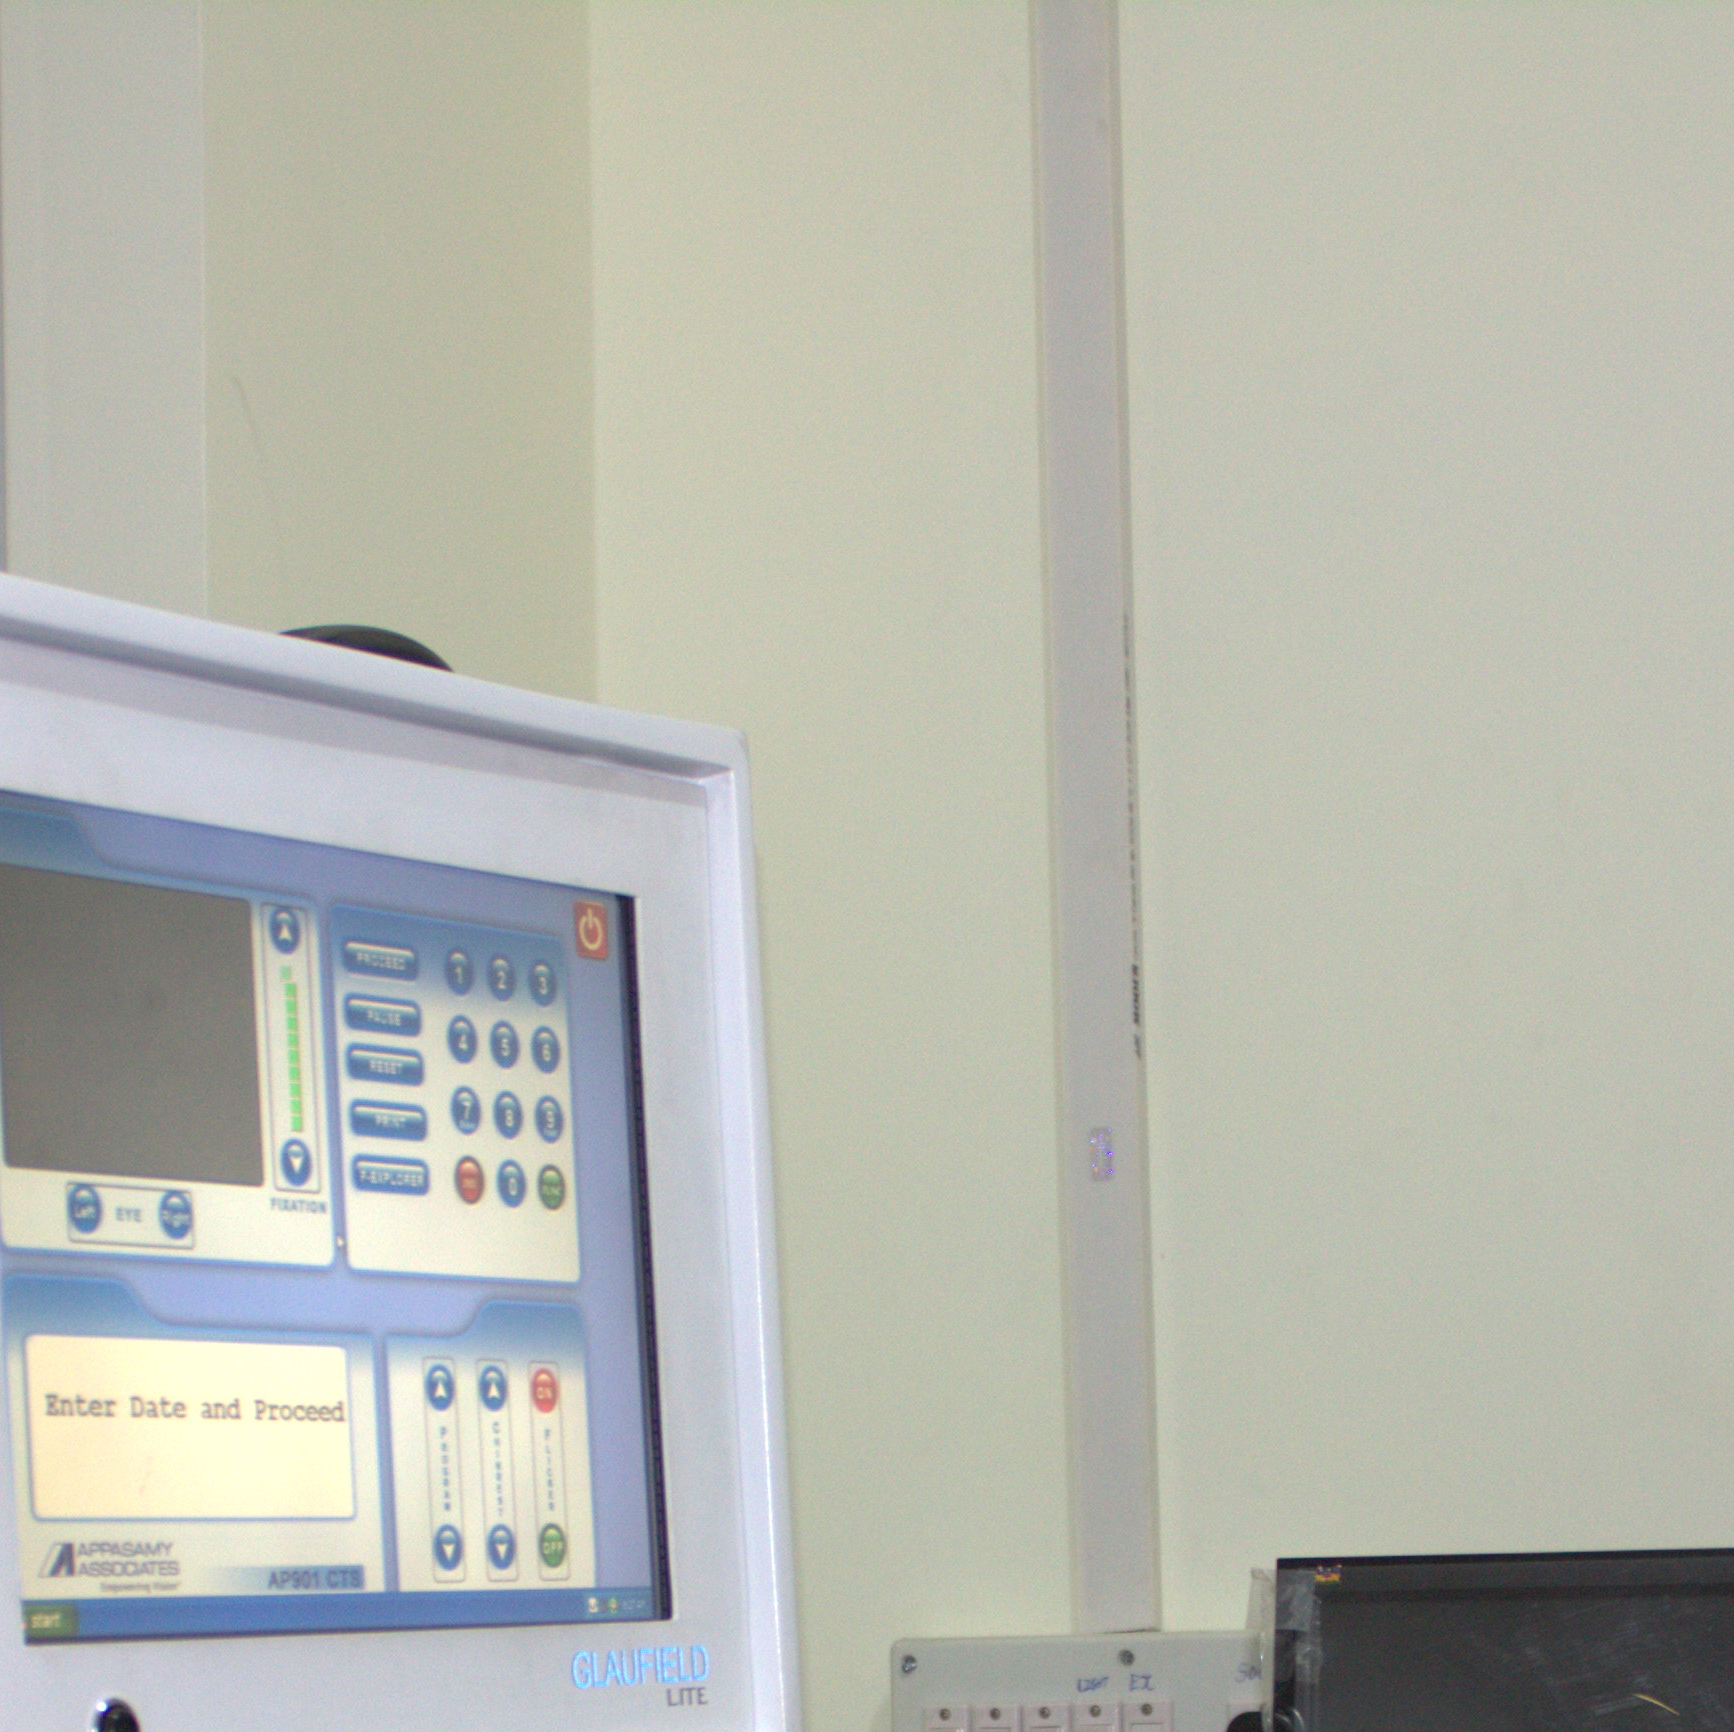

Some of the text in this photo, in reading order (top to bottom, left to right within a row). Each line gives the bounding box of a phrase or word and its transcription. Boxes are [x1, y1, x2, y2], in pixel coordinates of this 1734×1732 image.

[356, 951, 406, 971] PROCEED
[454, 965, 548, 995] 1 2 3
[458, 1033, 551, 1062] 4 5 6
[369, 1060, 403, 1075] RESET
[375, 1114, 406, 1129] PRINT
[461, 1100, 555, 1129] 7 8 9
[507, 1177, 517, 1196] 0
[270, 1197, 328, 1214] FIXATION
[73, 1203, 190, 1228] Left EYE Right
[536, 1385, 553, 1399] ON
[44, 1394, 346, 1423] Enter Date and Proceed
[77, 1542, 175, 1558] APPASAMY
[542, 1541, 564, 1554] OFF
[78, 1560, 181, 1578] ASSOCIATES
[267, 1569, 362, 1590] AP901 CTS
[30, 1612, 62, 1629] start
[571, 1644, 710, 1690] GLAUFIELD
[667, 1686, 709, 1707] LITE
